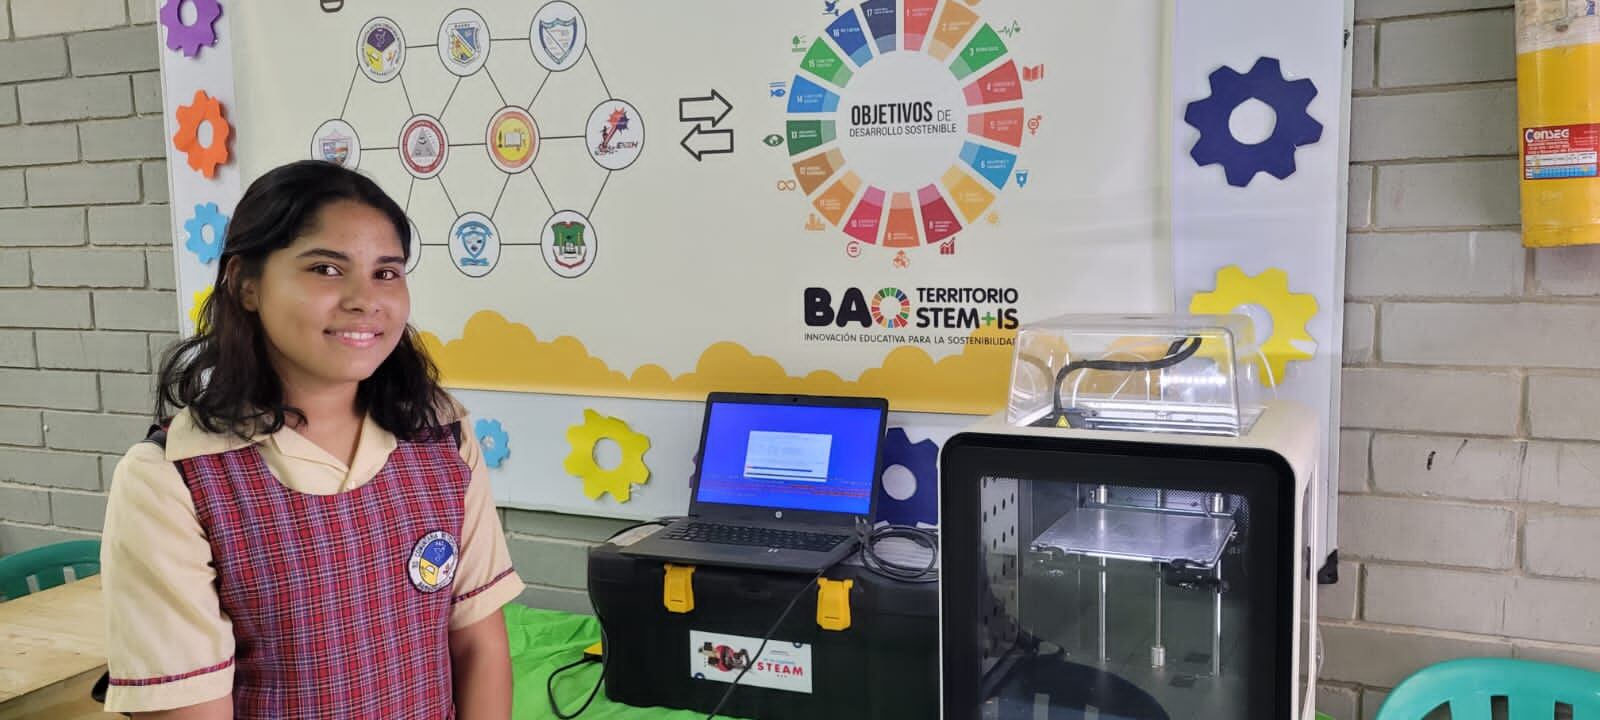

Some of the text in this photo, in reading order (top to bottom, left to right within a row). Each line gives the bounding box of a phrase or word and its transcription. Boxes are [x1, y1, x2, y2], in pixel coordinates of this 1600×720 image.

[851, 101, 952, 126] OBJETIVOS DE
[849, 123, 957, 137] DESARROLLO SOSTENIBLE
[916, 287, 1019, 304] TERRITORIO
[916, 307, 1019, 329] STEM+IS
[804, 332, 857, 342] INNOVACIÓN
[859, 334, 905, 344] EDUCATIVA
[908, 336, 931, 344] PARA
[934, 336, 945, 344] LA
[757, 661, 804, 676] STEAM
